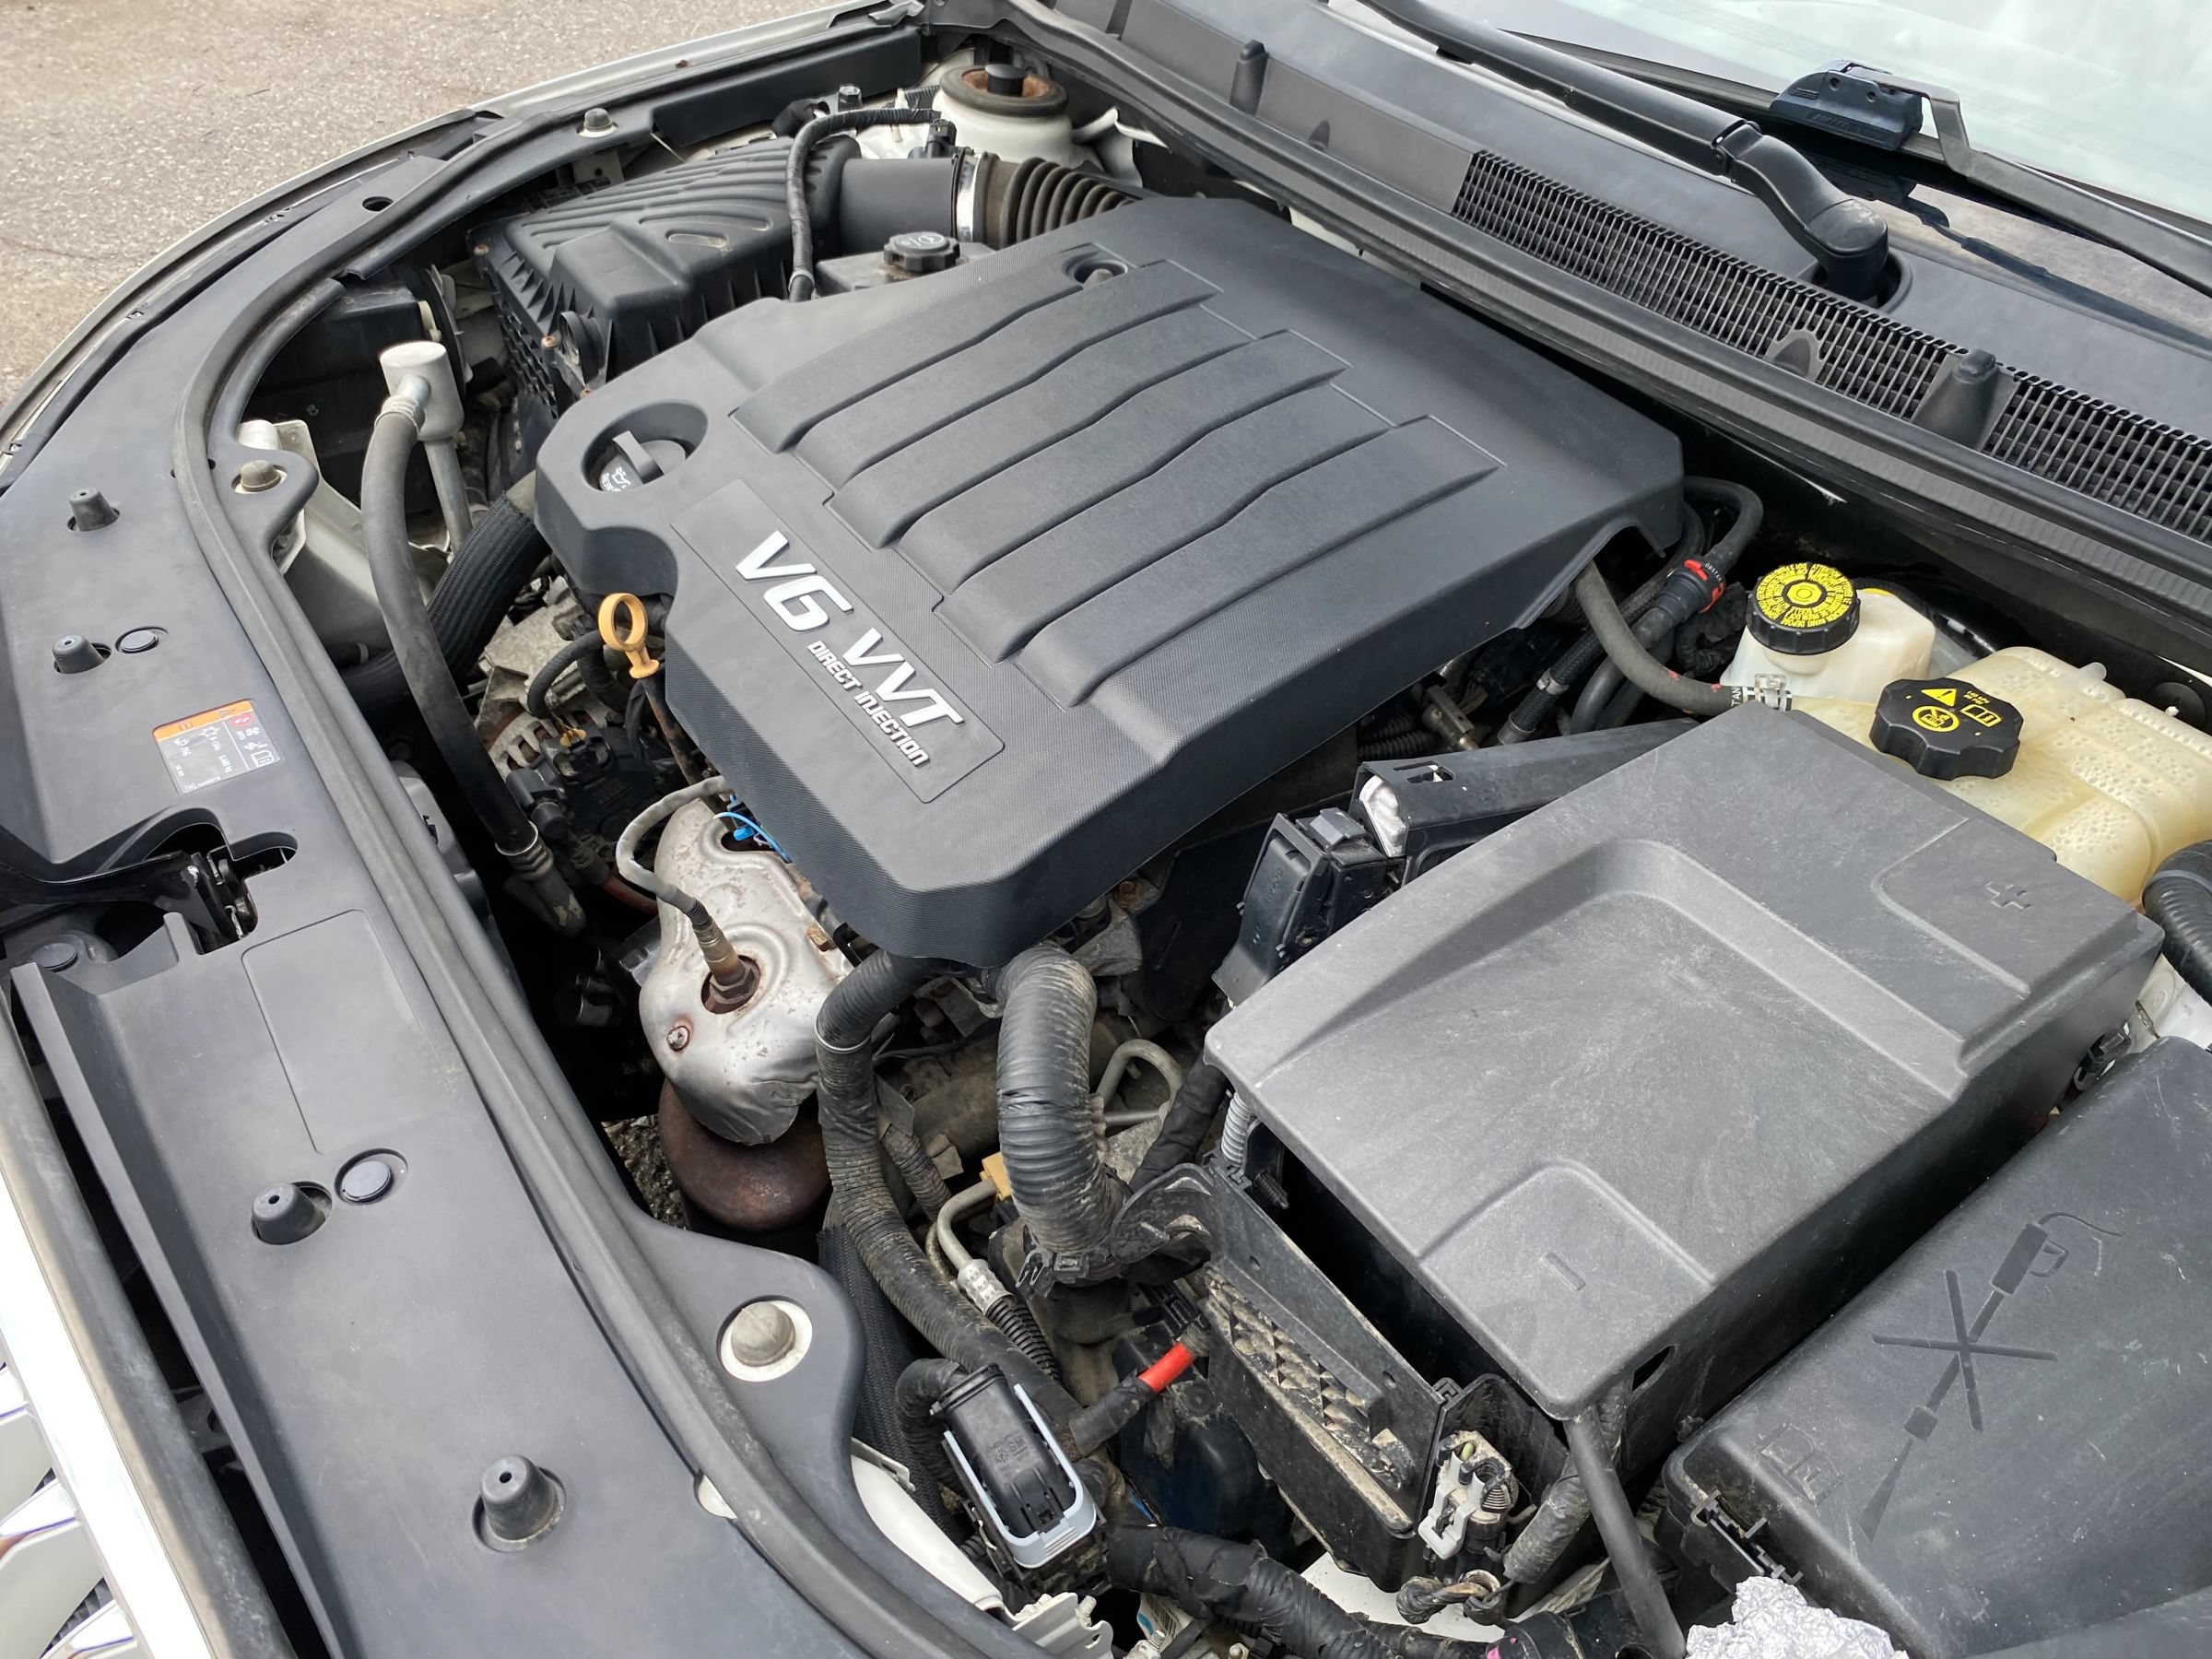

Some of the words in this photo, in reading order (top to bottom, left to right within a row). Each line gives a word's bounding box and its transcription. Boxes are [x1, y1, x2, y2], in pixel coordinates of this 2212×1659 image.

[735, 530, 853, 631] V6
[841, 627, 965, 727] VVT
[807, 641, 862, 690] DIRECT
[854, 691, 931, 767] INJECTION
